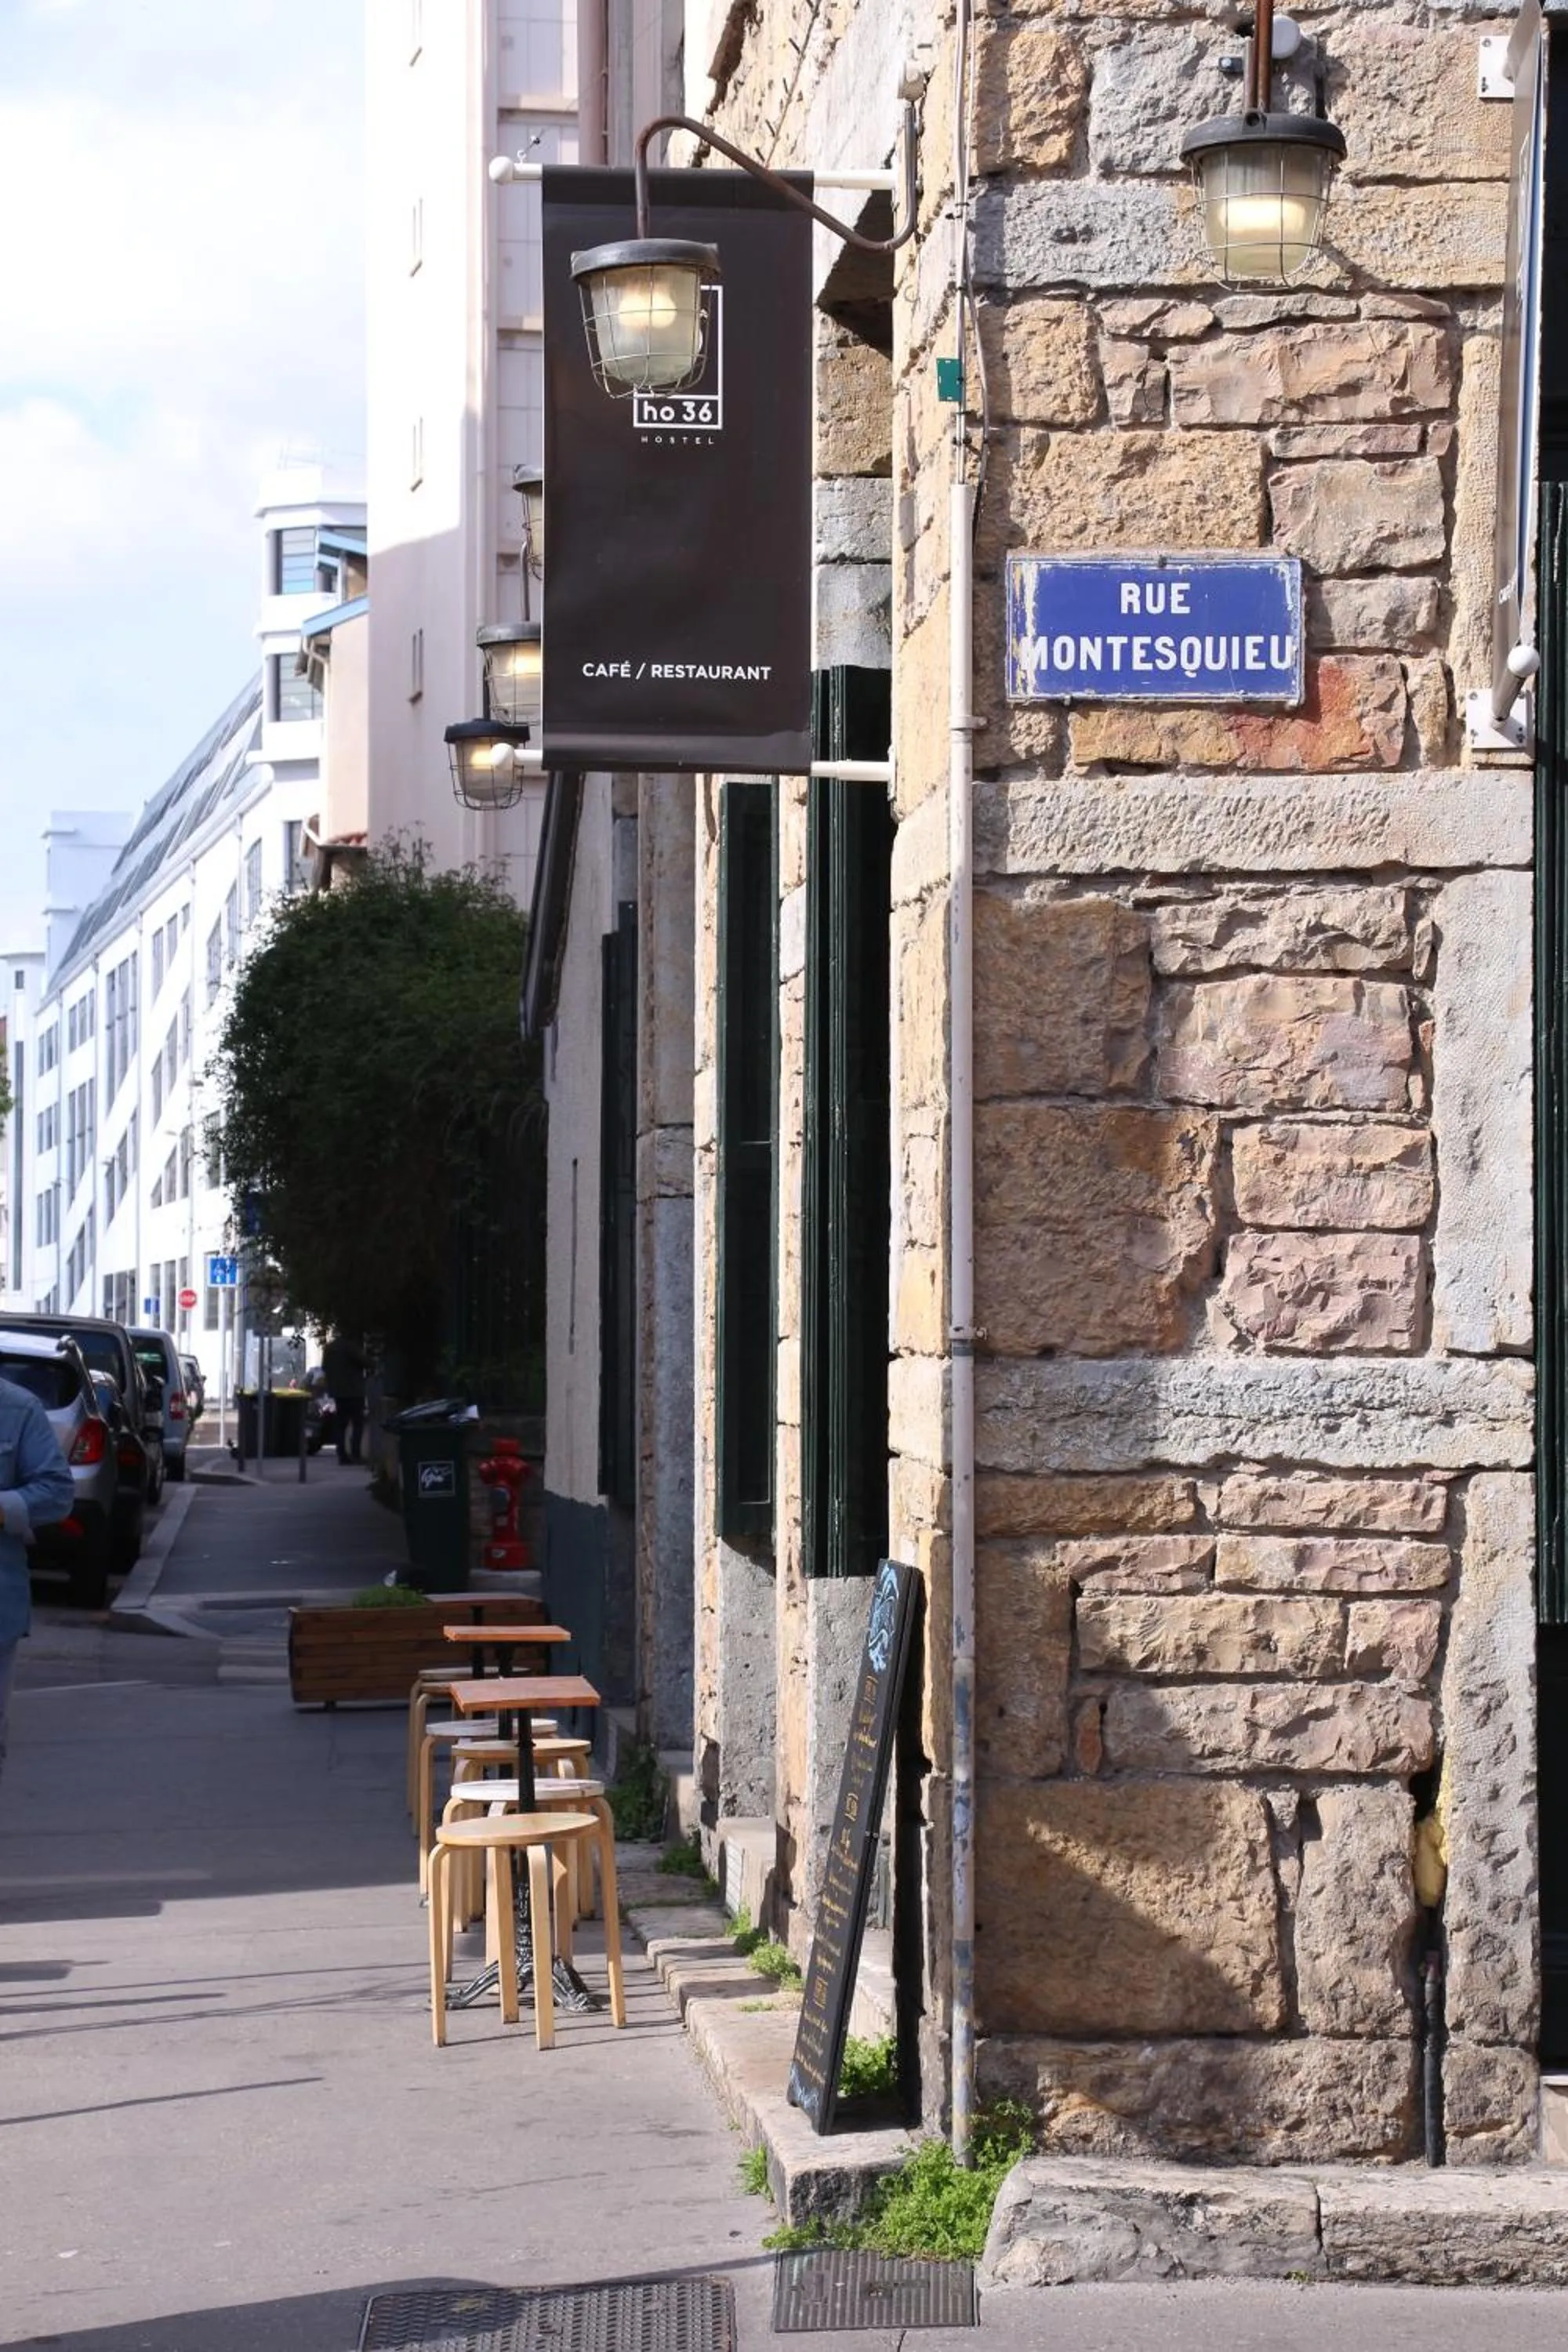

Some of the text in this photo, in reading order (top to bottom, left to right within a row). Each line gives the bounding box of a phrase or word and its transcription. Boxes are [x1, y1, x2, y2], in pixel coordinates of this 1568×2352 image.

[644, 401, 712, 423] ho 36
[641, 435, 714, 445] HOSTEL
[1120, 583, 1191, 615] RUE
[1020, 635, 1294, 678] MONTESQUIEU
[582, 660, 631, 678] CAFÉ
[651, 664, 771, 681] RESTAURANT
